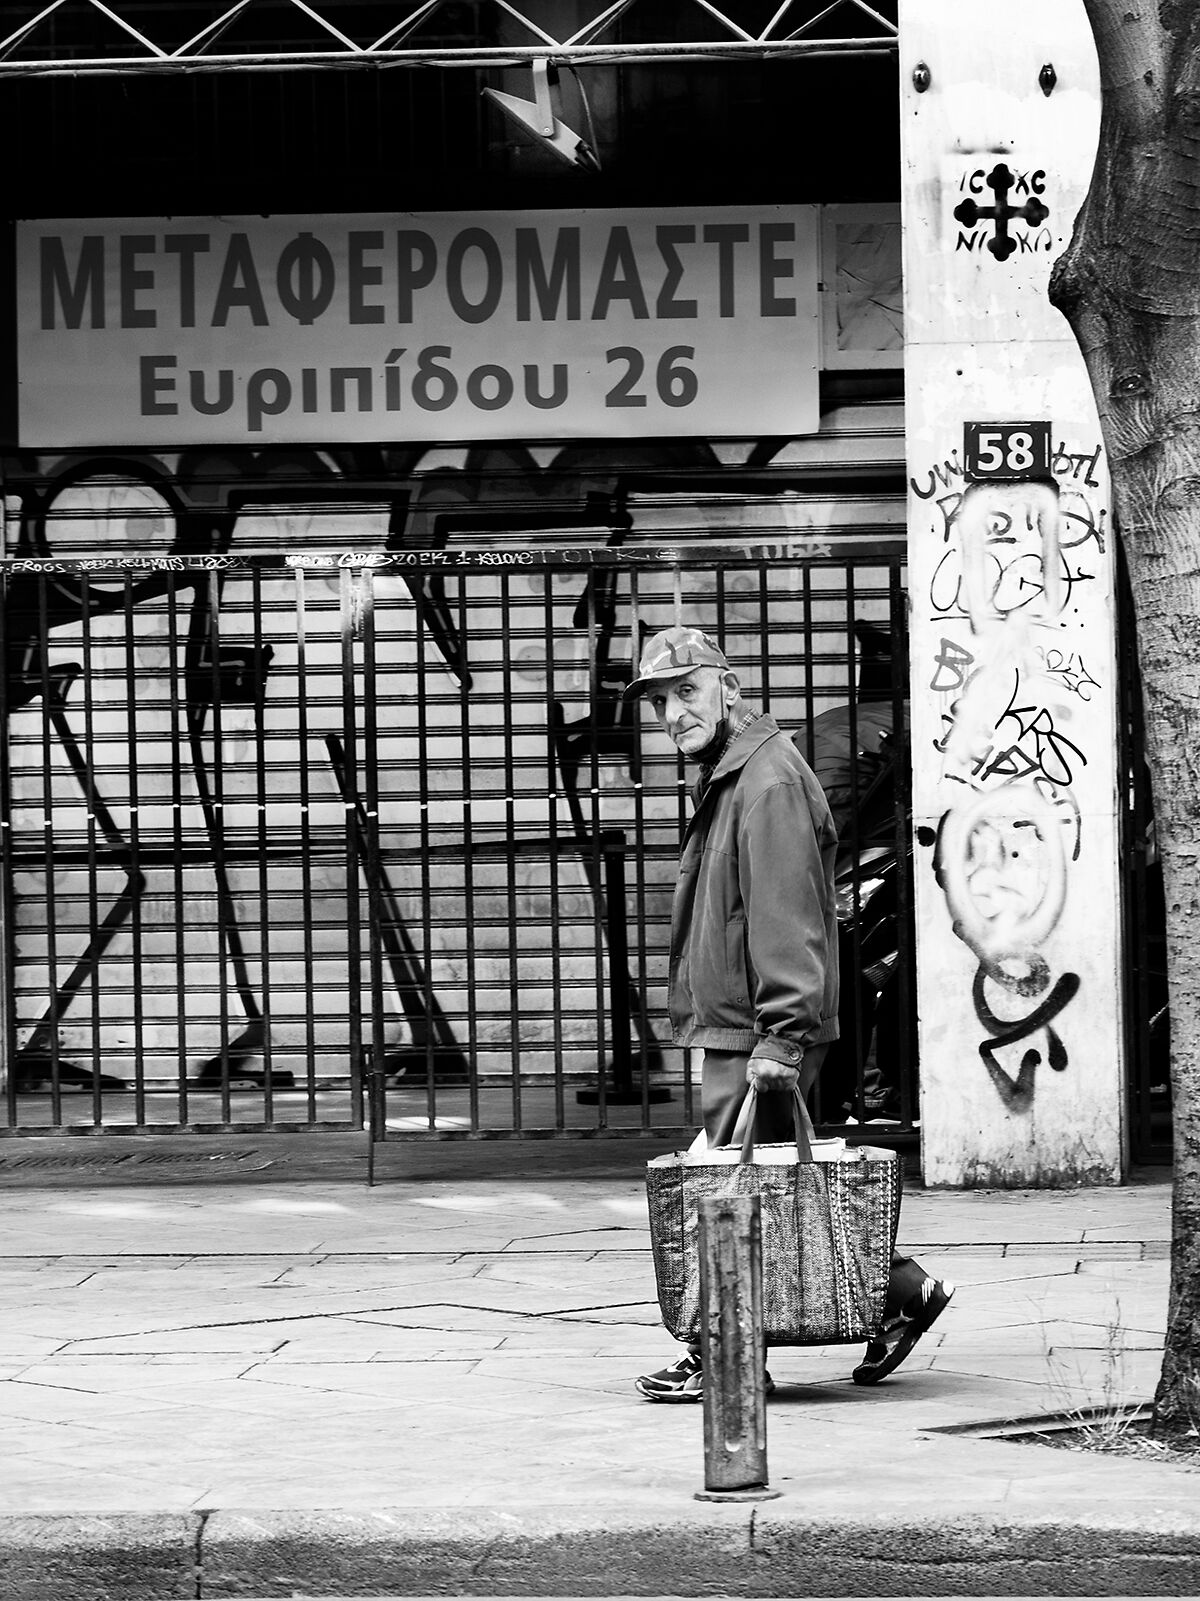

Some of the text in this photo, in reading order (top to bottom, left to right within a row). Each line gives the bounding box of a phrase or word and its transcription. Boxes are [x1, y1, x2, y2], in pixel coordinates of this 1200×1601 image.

[40, 222, 798, 331] ΜΕΤΑΦΕΡΟΜΑΣΤΕ
[138, 345, 700, 433] Ευριπίδου 26
[976, 431, 1035, 472] 58
